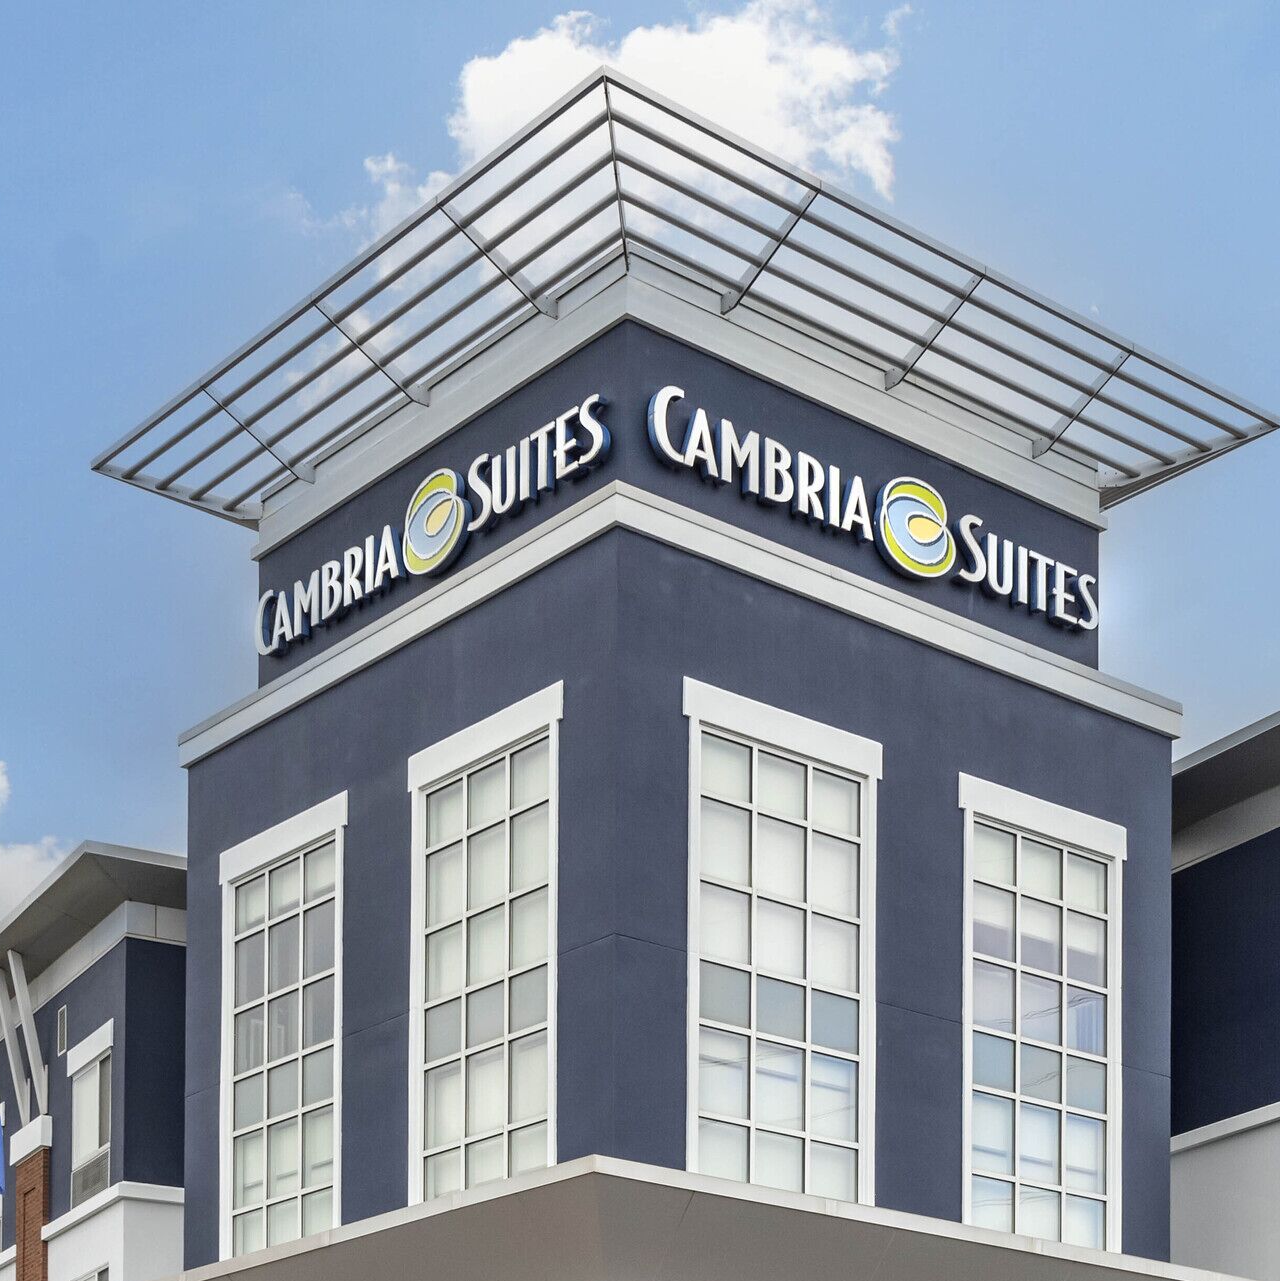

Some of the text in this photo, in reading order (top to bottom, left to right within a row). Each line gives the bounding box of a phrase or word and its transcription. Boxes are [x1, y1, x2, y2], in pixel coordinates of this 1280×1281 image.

[255, 393, 610, 656] CAMBRIA SUITES
[648, 385, 1099, 630] CAMBRIA SUITES
